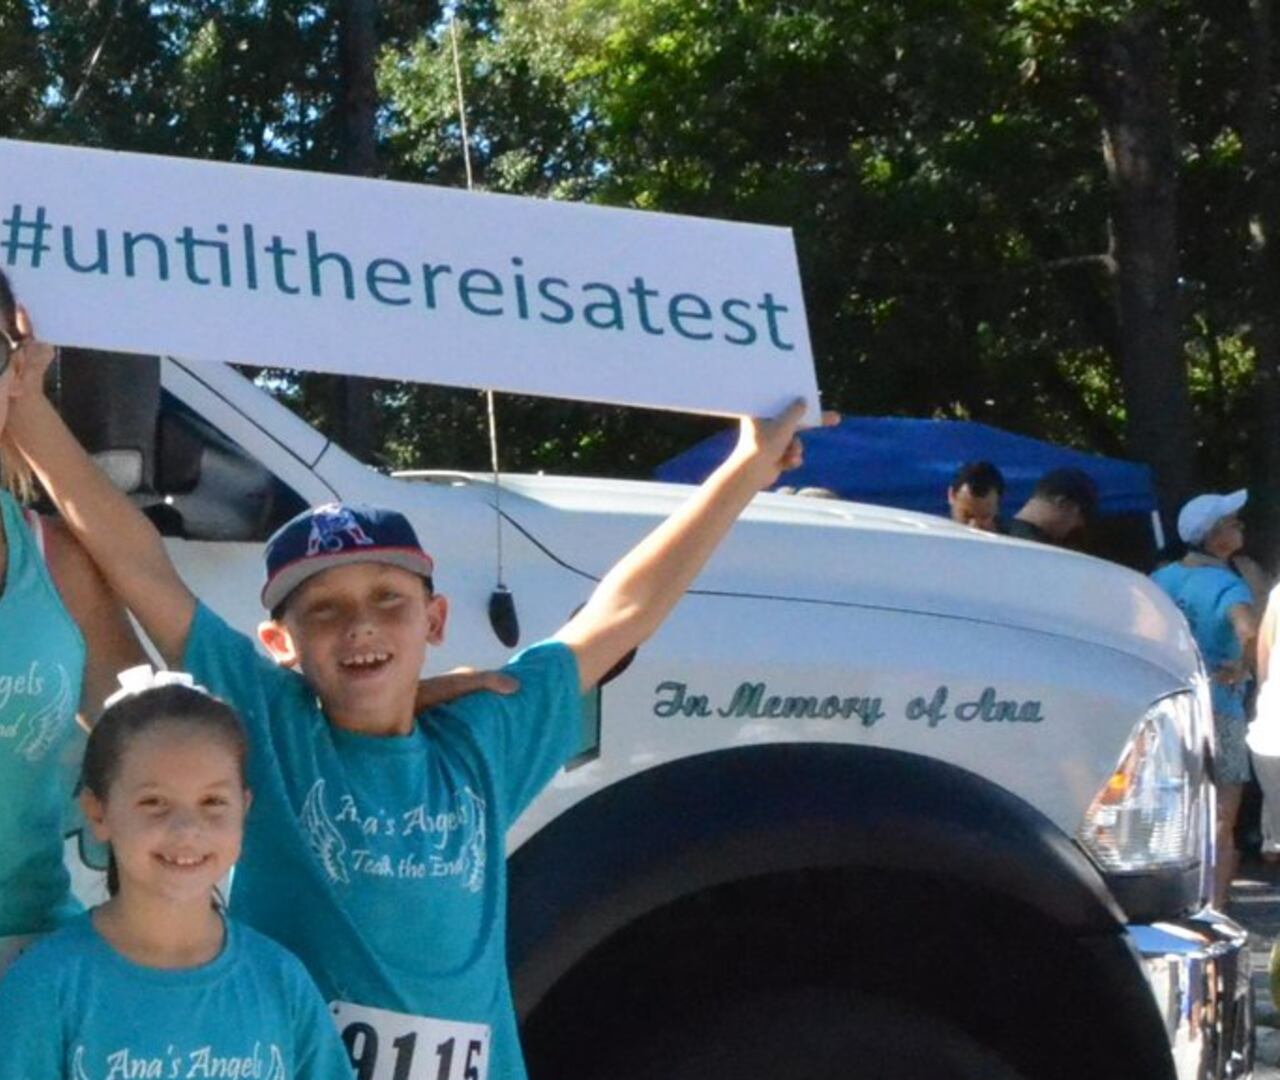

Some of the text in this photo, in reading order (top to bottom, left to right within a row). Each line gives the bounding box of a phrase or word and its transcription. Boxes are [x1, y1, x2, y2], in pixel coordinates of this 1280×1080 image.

[0, 204, 795, 351] #untilthereisatest
[653, 681, 1045, 728] In Memory of Ana
[398, 853, 426, 878] the
